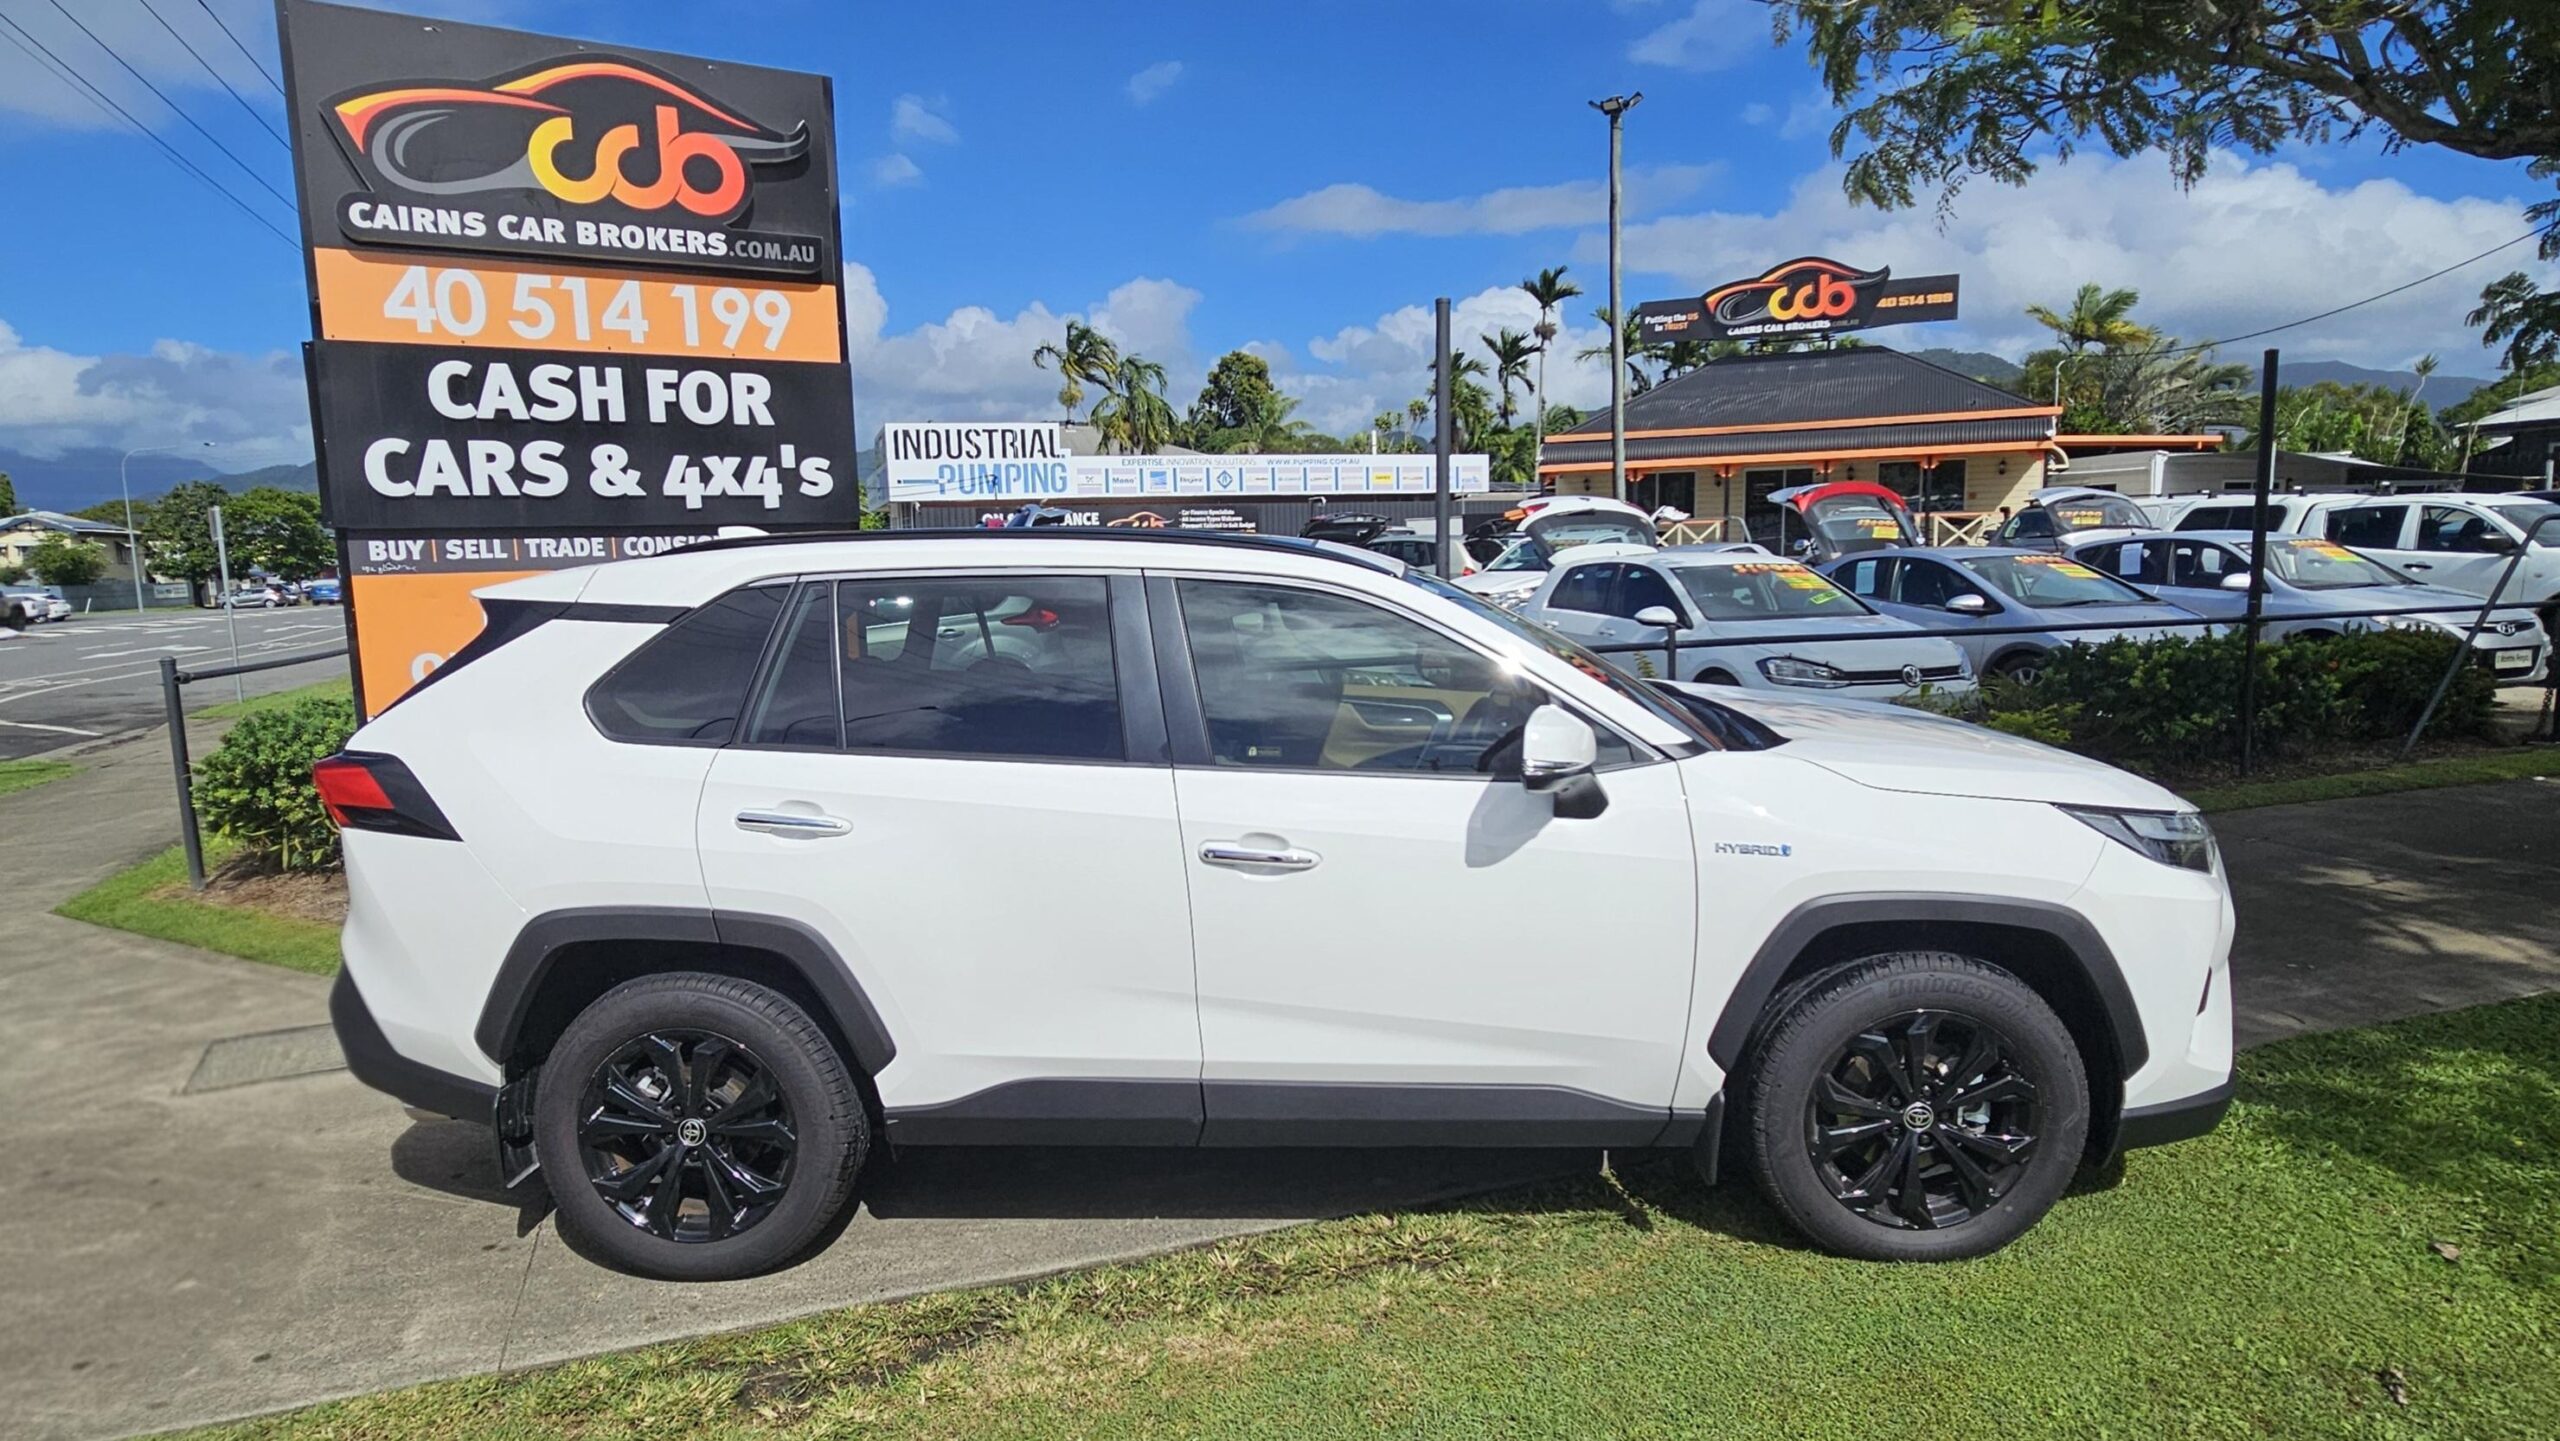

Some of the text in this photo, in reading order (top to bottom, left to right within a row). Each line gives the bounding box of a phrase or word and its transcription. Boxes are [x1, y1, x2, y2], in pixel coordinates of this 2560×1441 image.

[349, 201, 487, 238] CAIRNS
[498, 214, 567, 244] CAR
[384, 266, 792, 352] 40 514 199
[1876, 297, 1896, 308] 40
[1898, 294, 1925, 306] 514
[1727, 325, 1762, 336] CAIRNS
[1764, 323, 1784, 333] CAR
[427, 360, 775, 426] CASH FOR
[893, 429, 1062, 460] INDUSTRIAL
[364, 437, 569, 497] CARS
[589, 443, 646, 496] &
[938, 463, 1067, 494] PUMPING
[369, 539, 425, 561] BUY
[445, 538, 507, 560] SELL
[524, 537, 606, 558] TRADE
[1714, 842, 1780, 857] HYBRID
